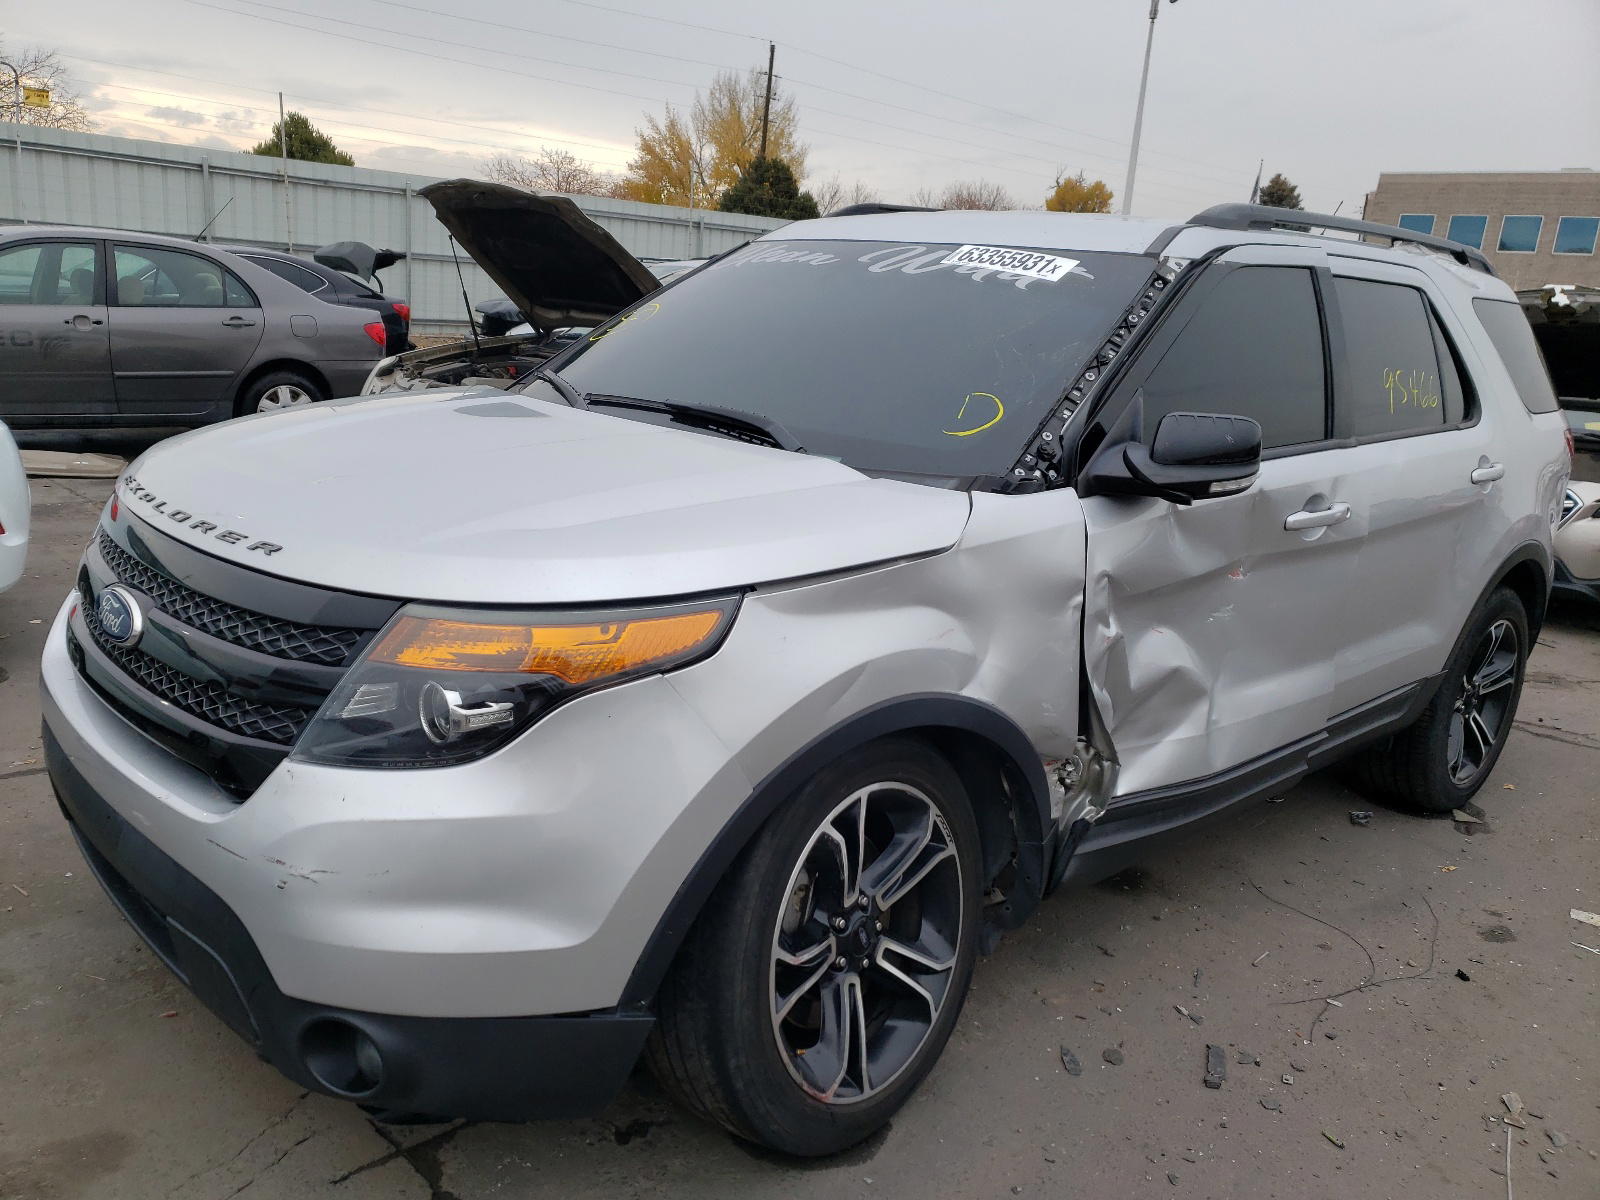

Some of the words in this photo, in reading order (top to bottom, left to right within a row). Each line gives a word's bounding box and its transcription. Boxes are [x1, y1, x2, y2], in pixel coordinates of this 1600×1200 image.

[1383, 367, 1439, 415] 95466
[942, 392, 1005, 437] D
[124, 475, 283, 556] EXPLORER
[99, 594, 125, 632] Ford
